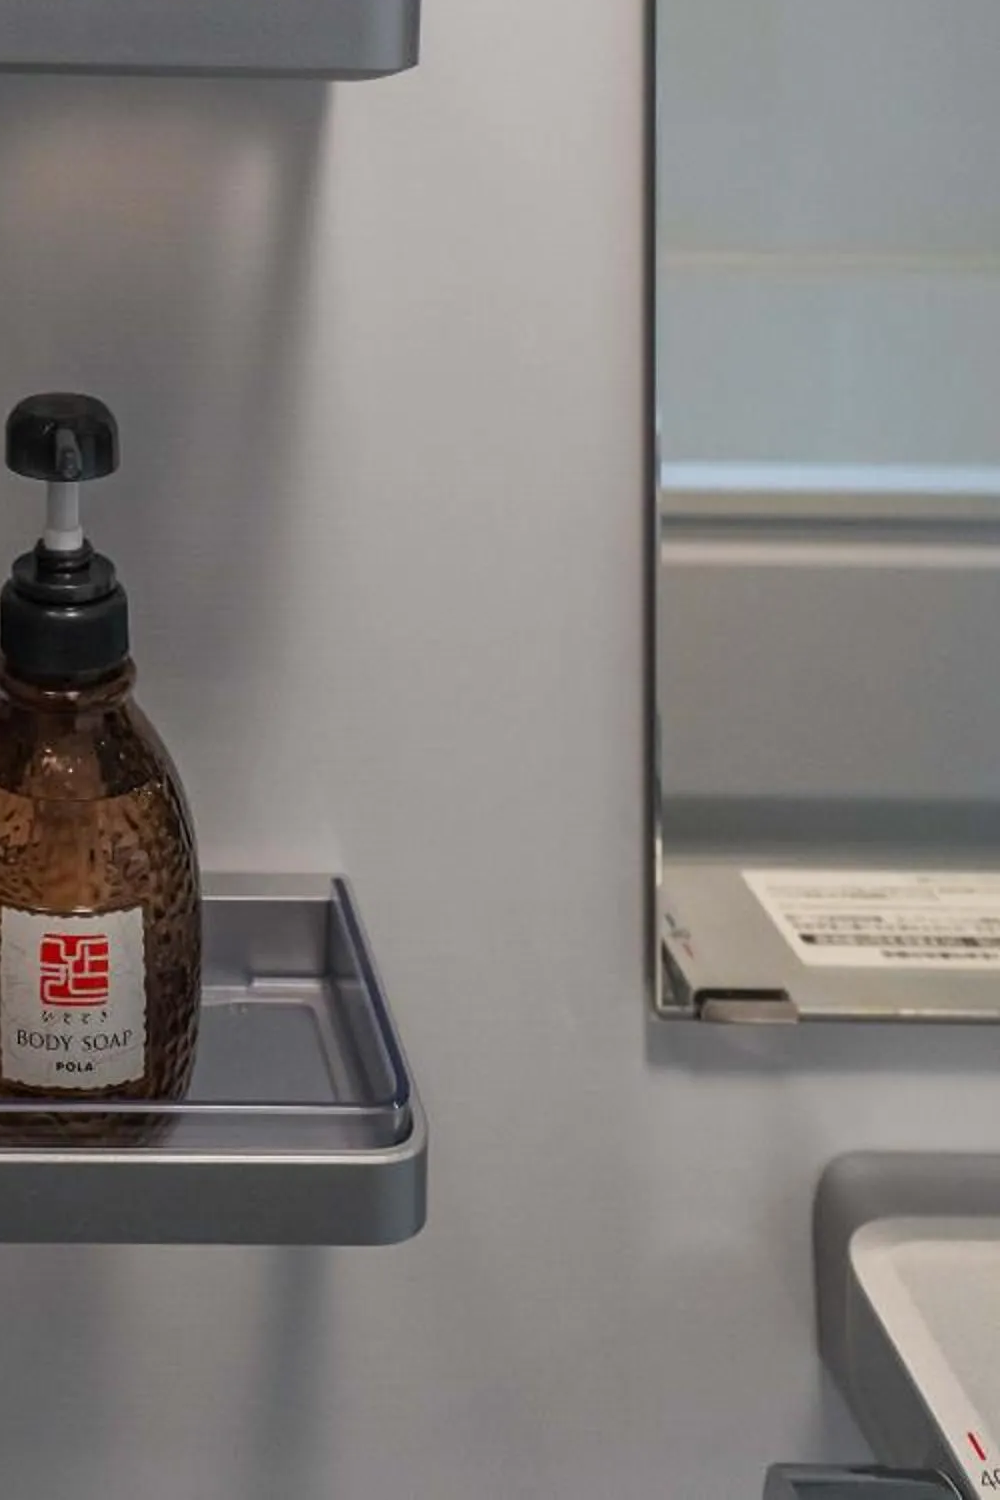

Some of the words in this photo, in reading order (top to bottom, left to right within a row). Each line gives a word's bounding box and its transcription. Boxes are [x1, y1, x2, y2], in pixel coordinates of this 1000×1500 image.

[16, 1029, 74, 1051] BODY
[81, 1029, 134, 1051] SOAP
[55, 1061, 94, 1073] POLA
